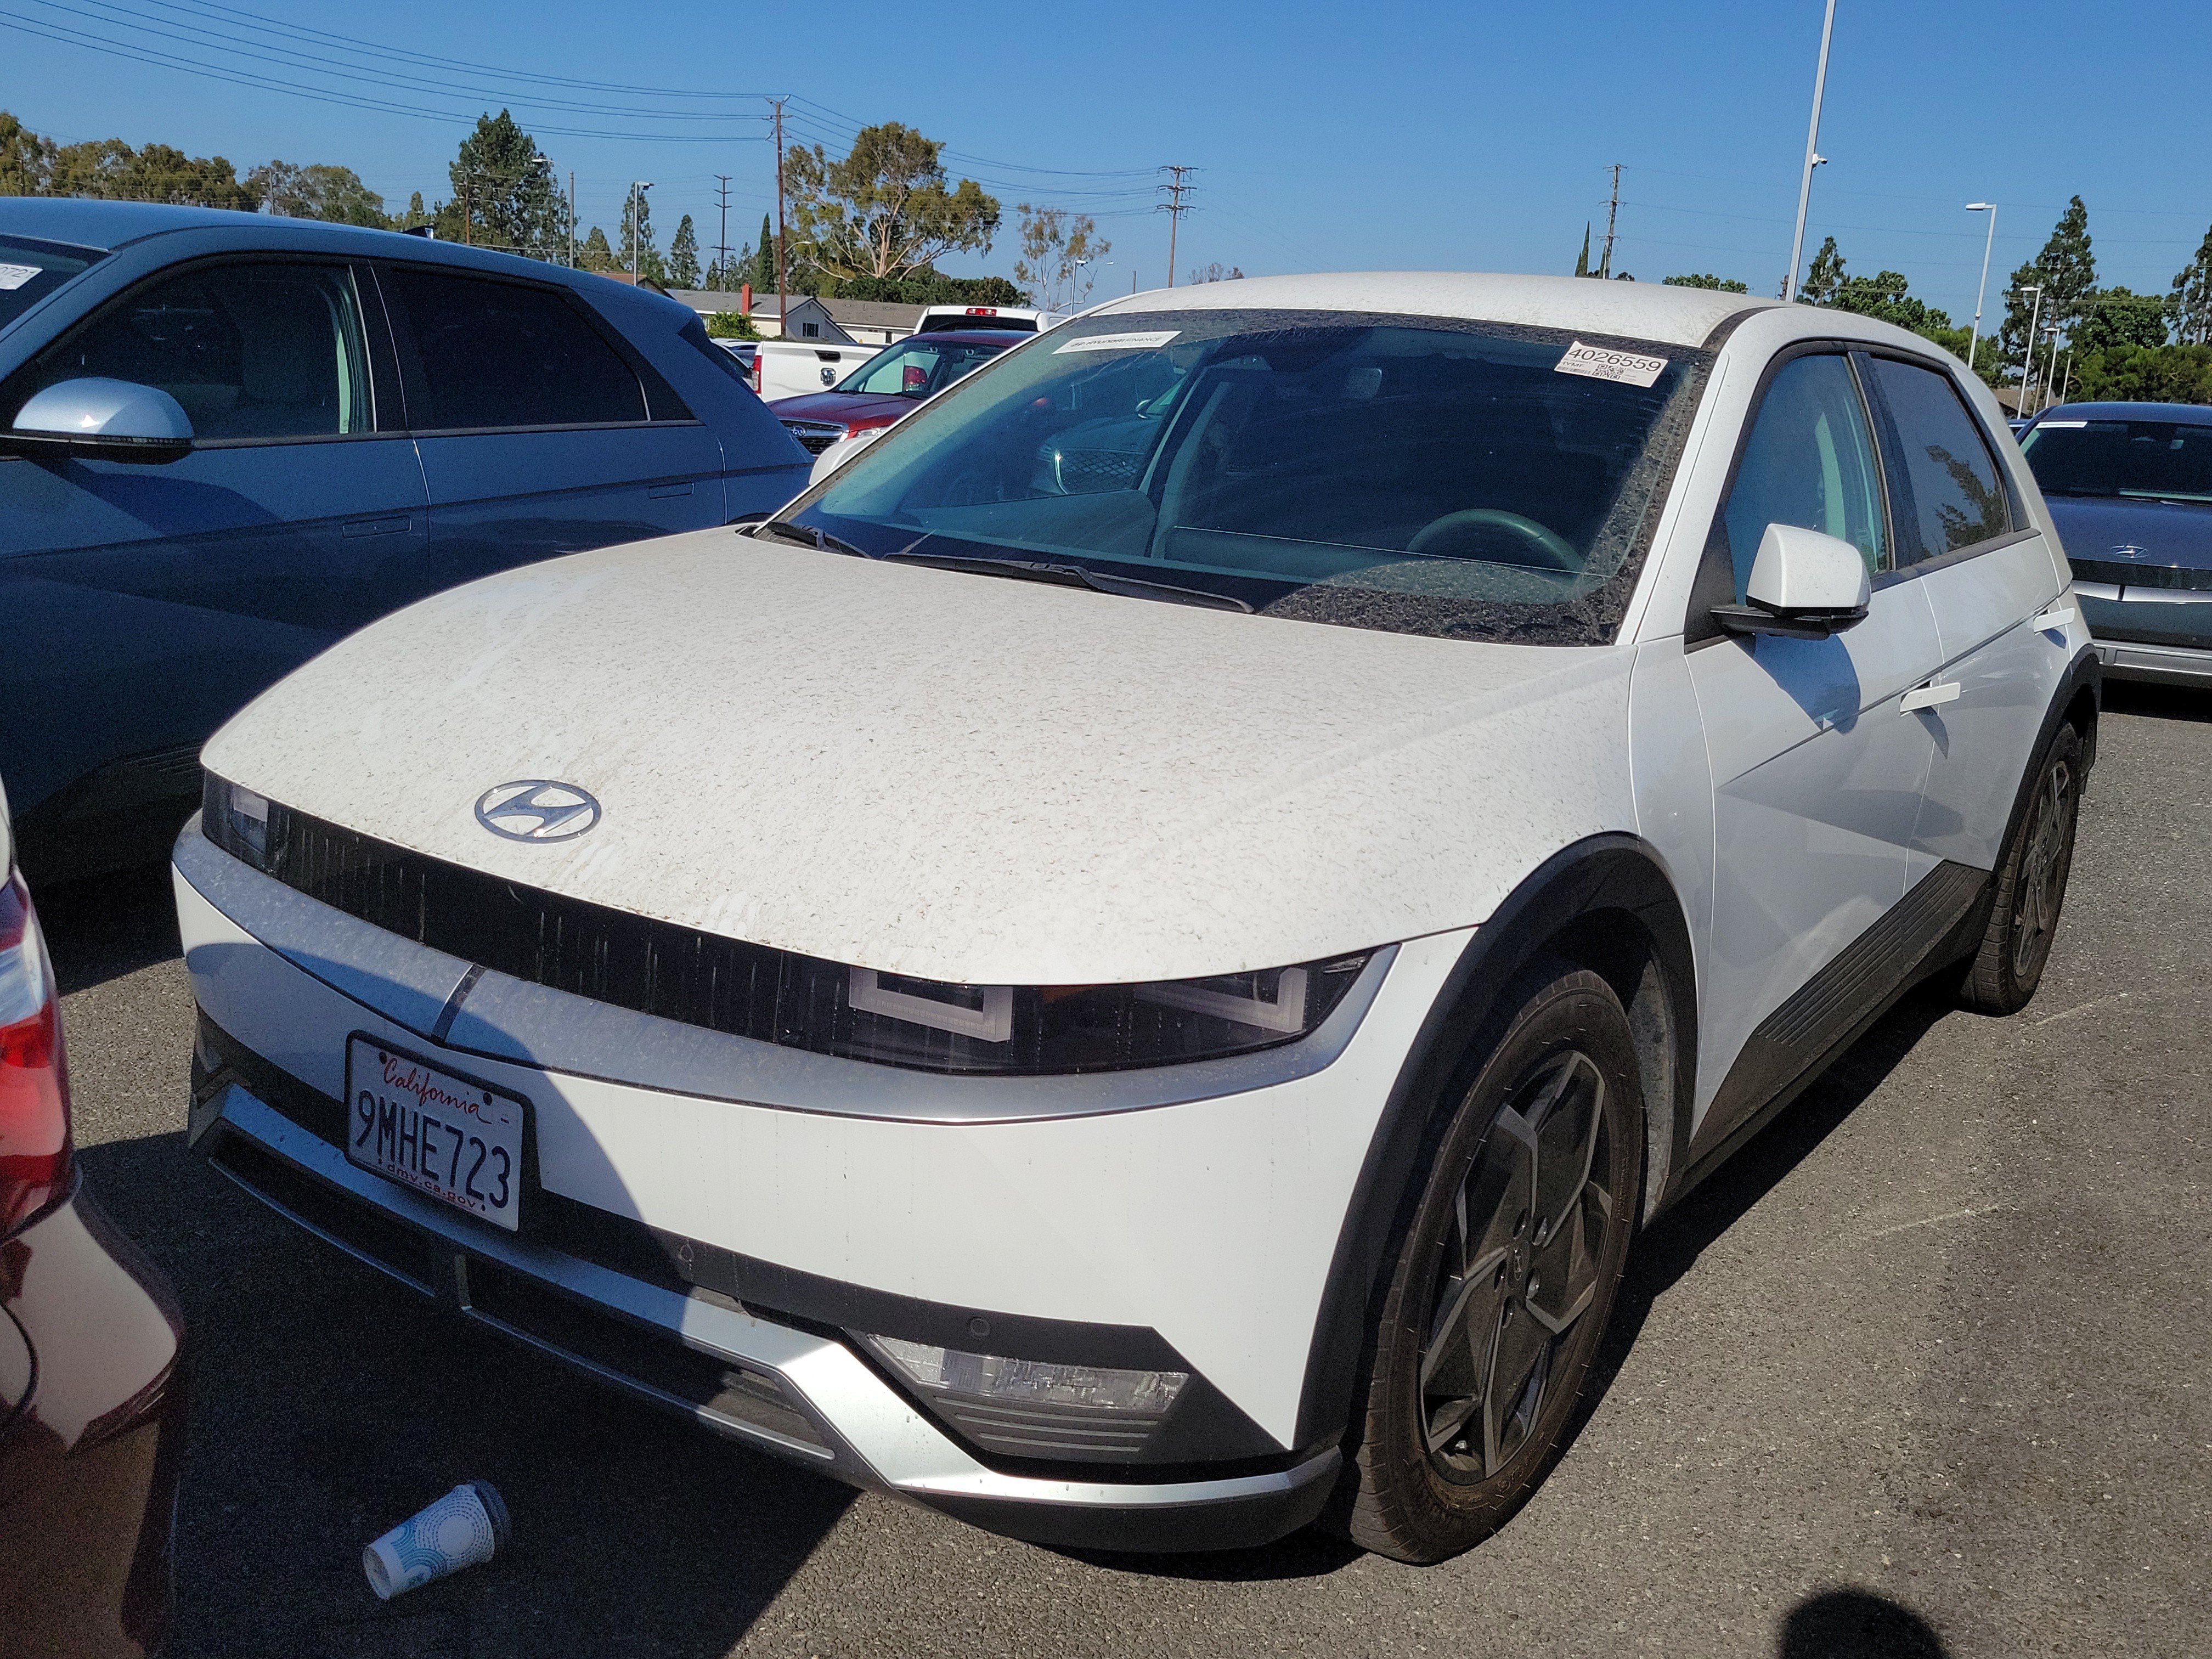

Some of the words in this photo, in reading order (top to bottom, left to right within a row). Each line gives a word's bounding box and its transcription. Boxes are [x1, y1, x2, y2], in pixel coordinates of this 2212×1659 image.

[1568, 348, 1662, 372] 4026559
[384, 1058, 492, 1124] California
[356, 1090, 511, 1209] 9MHE723
[387, 1164, 476, 1209] dmv.ca.gov
